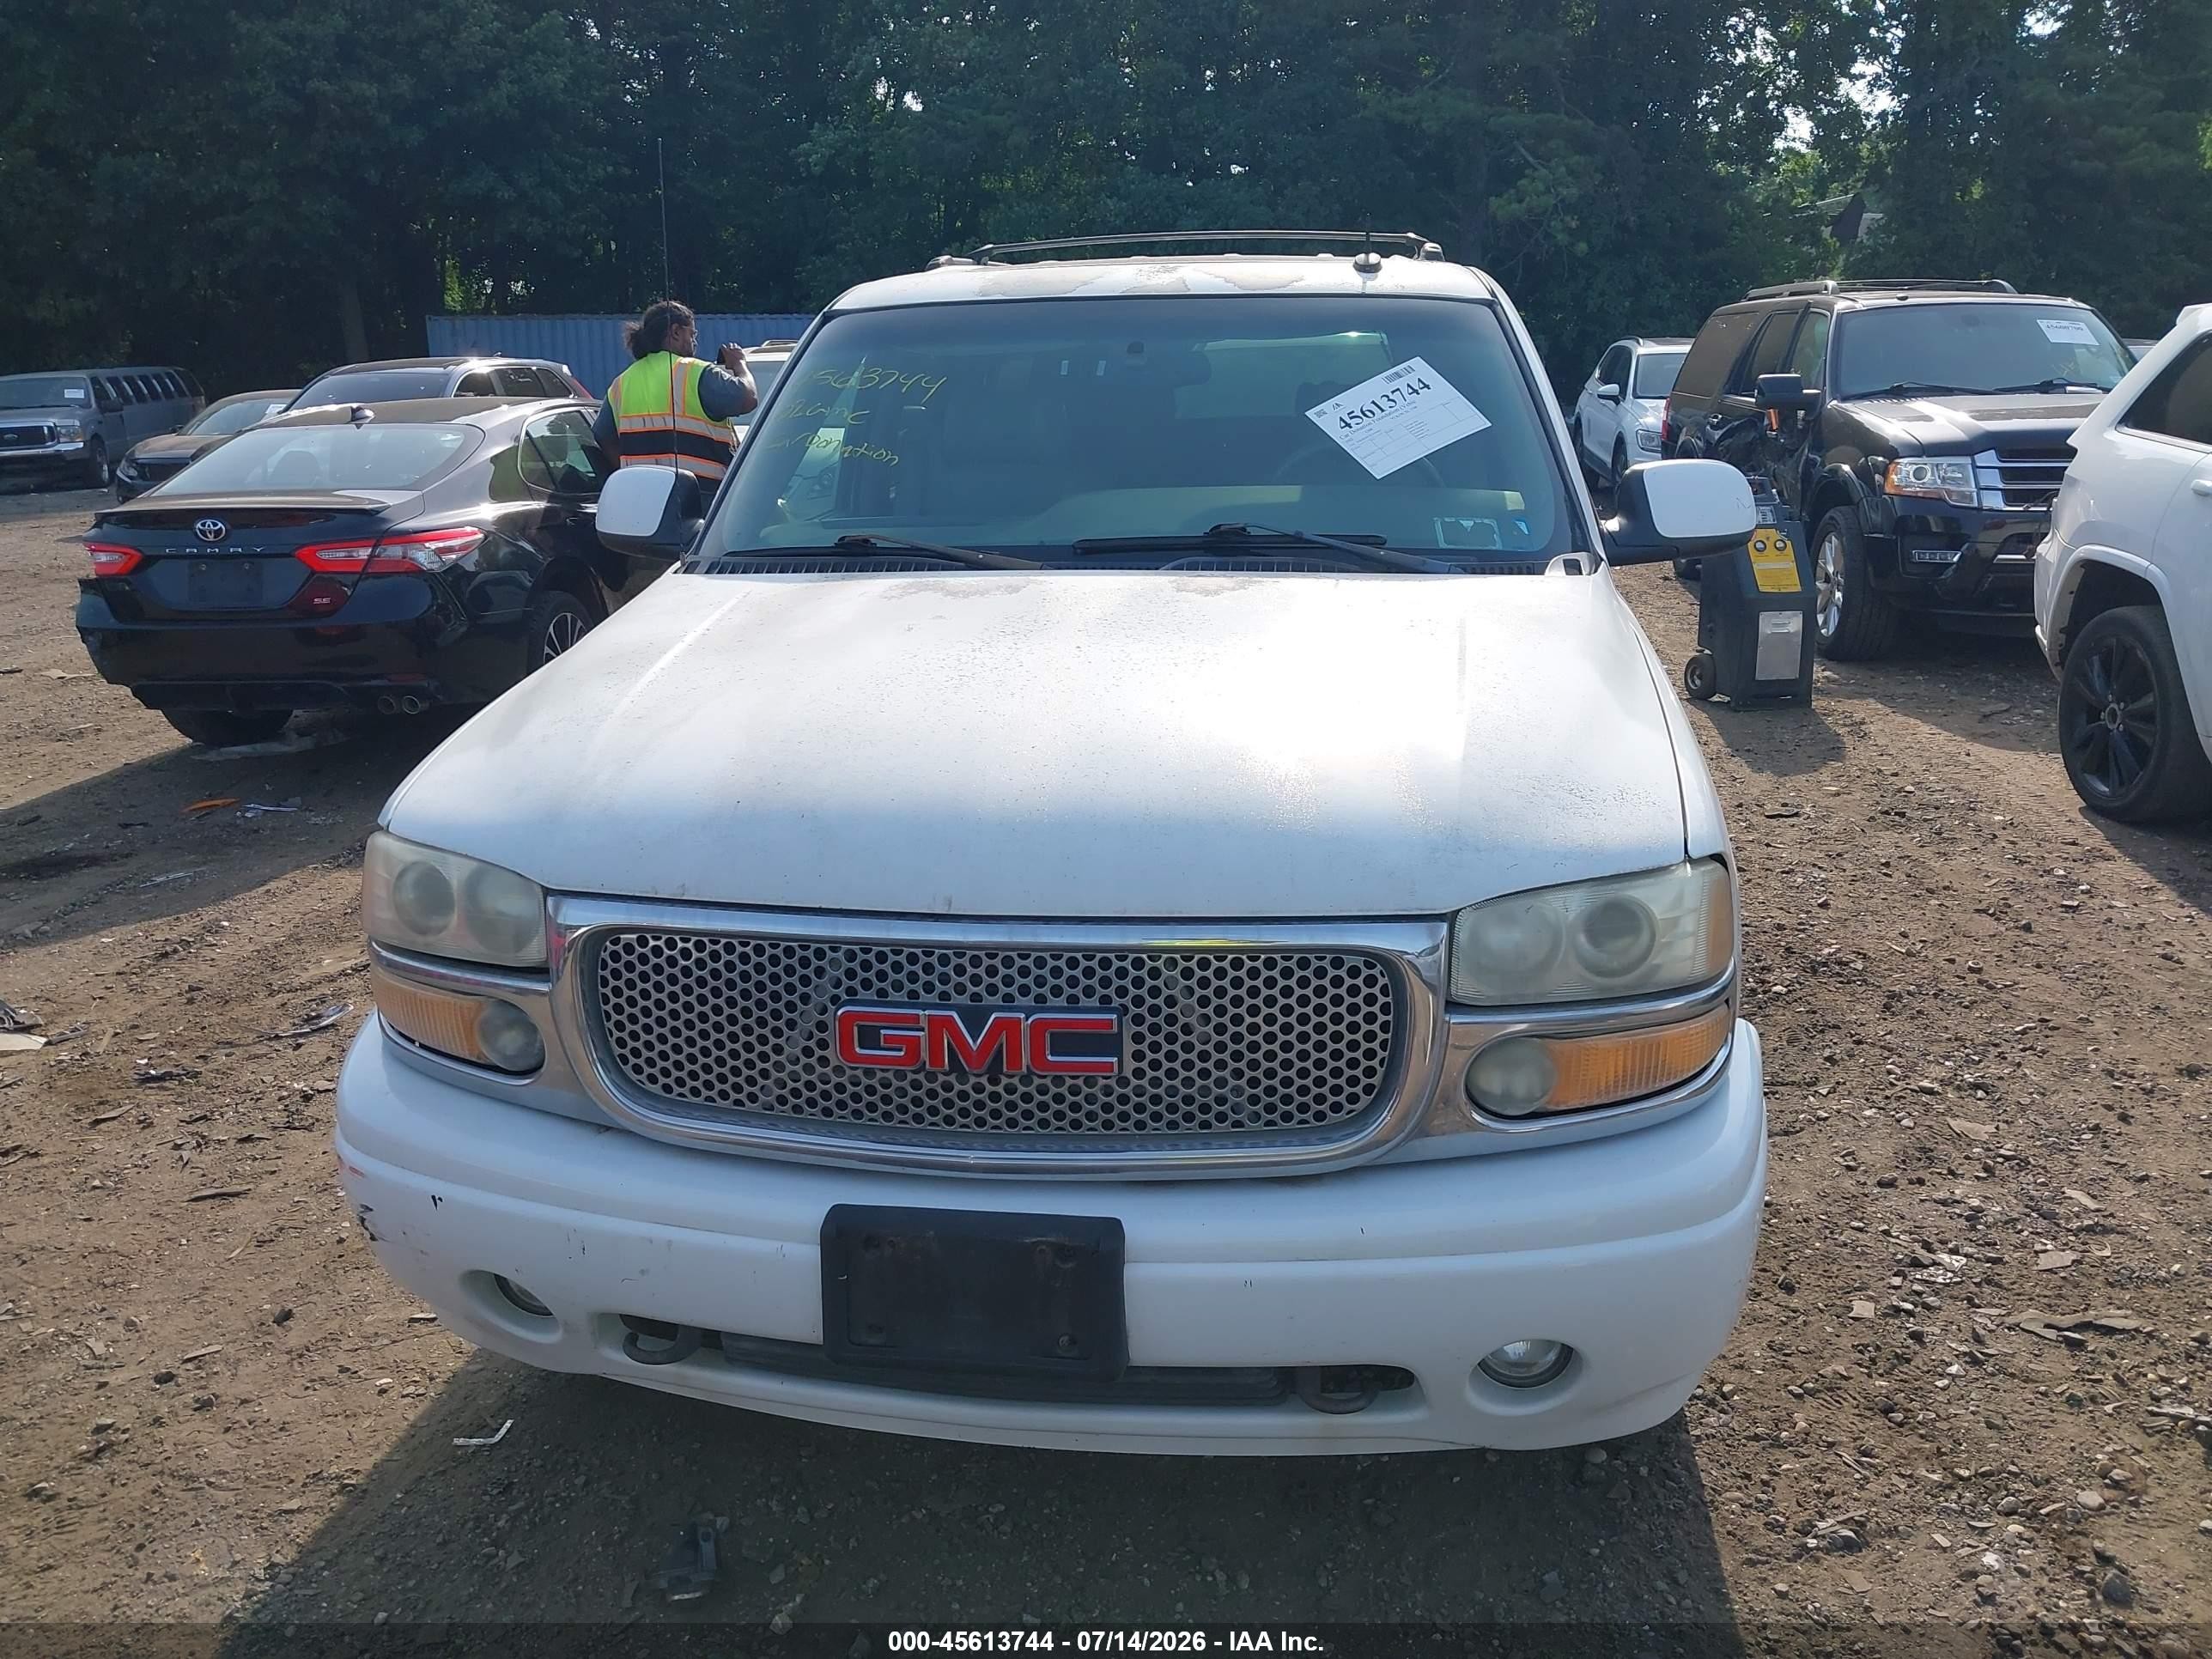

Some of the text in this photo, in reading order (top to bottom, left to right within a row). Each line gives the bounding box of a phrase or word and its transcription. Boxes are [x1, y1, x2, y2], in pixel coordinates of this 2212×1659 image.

[1338, 377, 1432, 432] 45613744
[165, 545, 265, 554] CAMRY
[836, 1006, 1119, 1075] GMC
